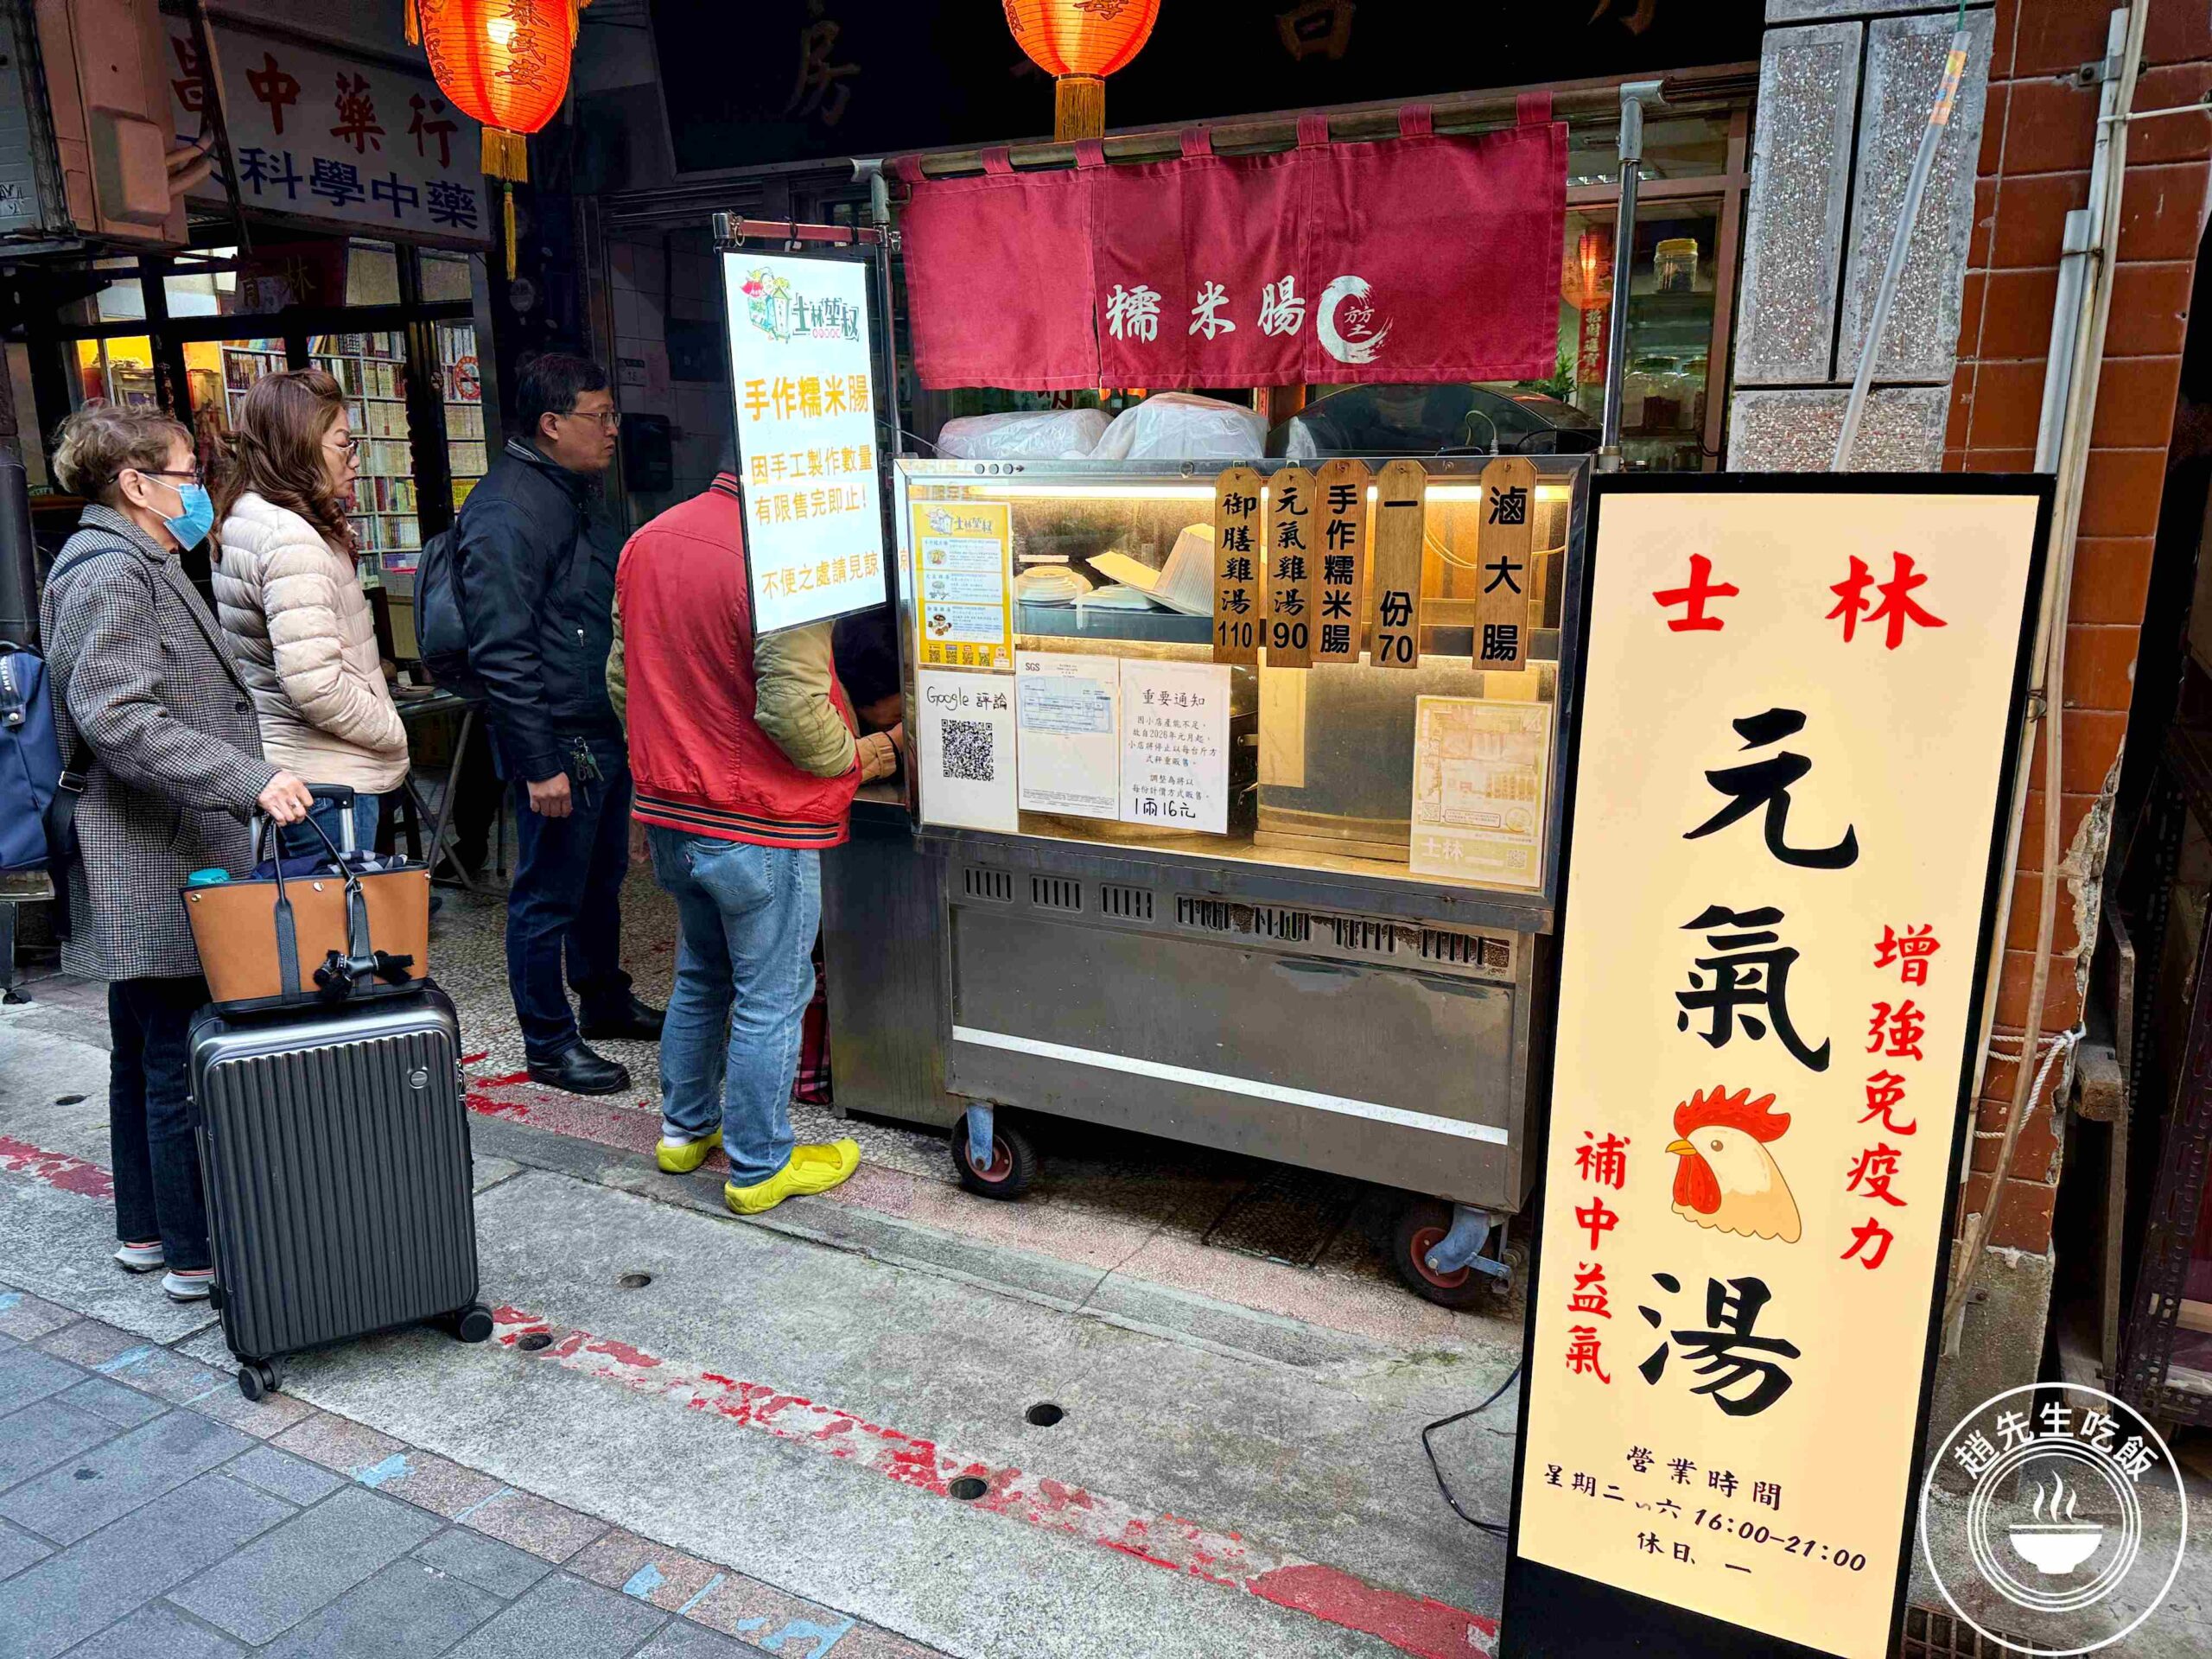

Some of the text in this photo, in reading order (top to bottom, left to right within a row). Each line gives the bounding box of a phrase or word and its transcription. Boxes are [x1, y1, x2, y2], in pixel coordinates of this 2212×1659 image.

[791, 293, 859, 341] 士林堃叔
[1106, 275, 1306, 344] 糯米腸
[1344, 306, 1374, 336] 堃
[744, 374, 868, 422] 手作糯米腸
[751, 444, 873, 486] 因手工製作數量
[761, 550, 879, 600] 不便之處請見諒
[1218, 492, 1256, 648] 御膳雞湯 110
[1273, 486, 1308, 649] 元氣雞湯 90
[1320, 484, 1357, 653] 手作糯米腸
[1379, 500, 1418, 663] 一份 70
[1480, 486, 1528, 661] 滷大腸
[1652, 551, 1948, 651] 士林
[927, 686, 969, 710] Google
[1026, 663, 1040, 671] SGS
[1142, 689, 1205, 707] 重要通知
[1840, 924, 1941, 1270] 增強免疫力
[1566, 1130, 1630, 1384] 補中益氣
[1626, 1445, 1782, 1511] 營業時間
[1695, 1509, 1866, 1571] 16:00-21:00
